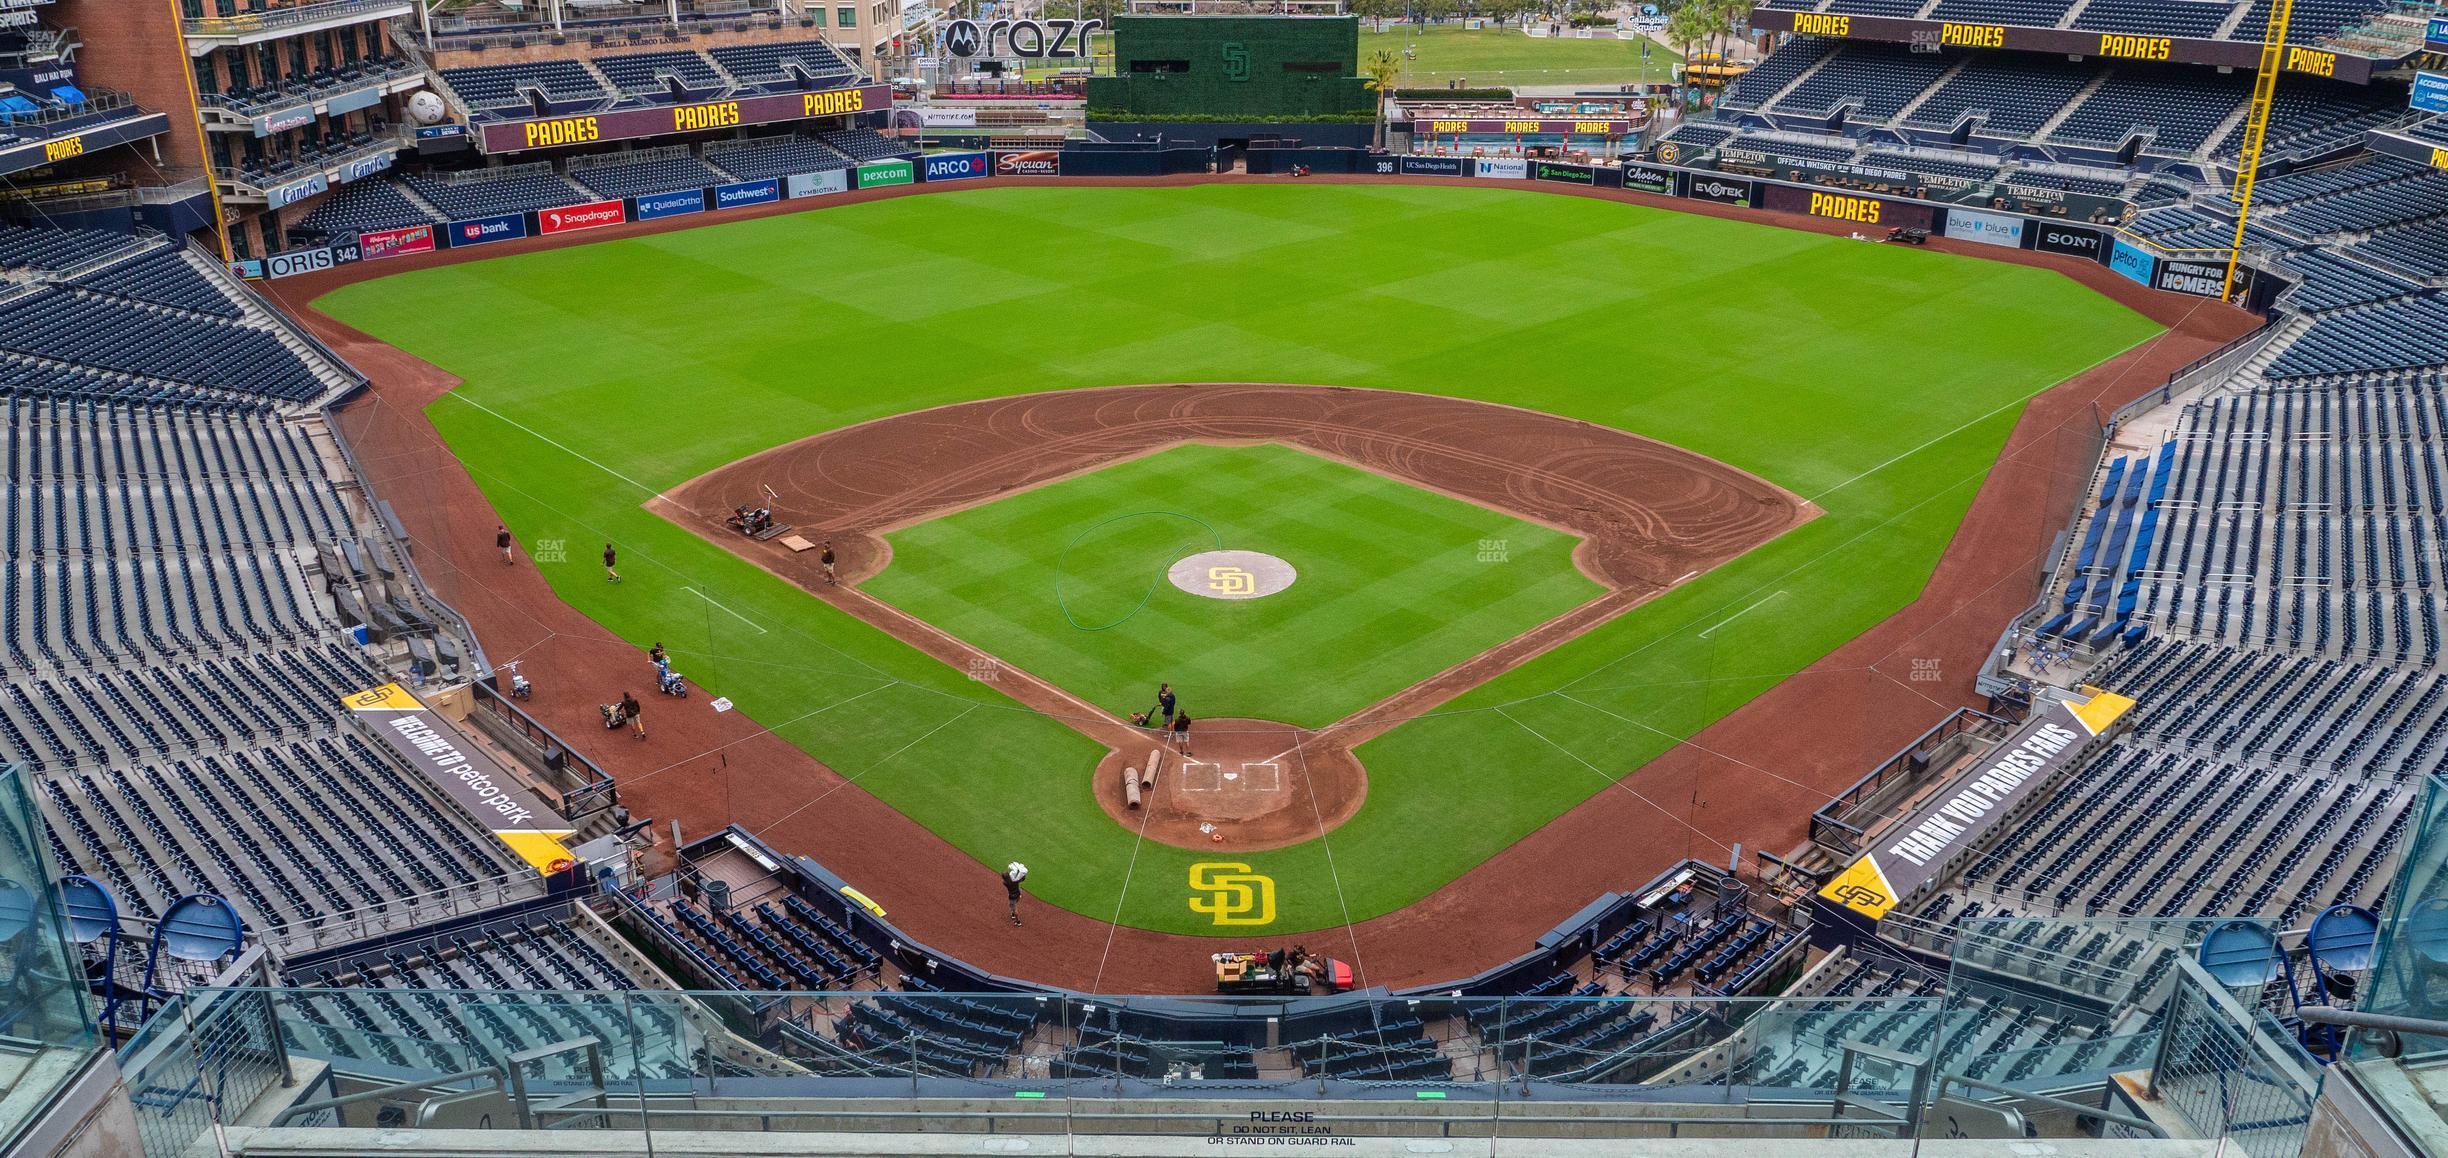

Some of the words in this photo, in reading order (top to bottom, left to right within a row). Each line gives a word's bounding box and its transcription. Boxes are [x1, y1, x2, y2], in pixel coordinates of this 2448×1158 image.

[1627, 15, 1669, 26] Gallagher
[1632, 24, 1662, 32] Square
[1794, 13, 1849, 36] PADRES
[986, 19, 1103, 58] razr
[1941, 23, 2004, 47] PADRES
[2100, 34, 2171, 60] PADRES
[2288, 48, 2335, 77] PADRES
[804, 90, 862, 116] PADRES
[673, 101, 739, 132] PADRES
[525, 117, 599, 147] PADRES
[1433, 120, 1467, 132] PADRES
[1505, 120, 1540, 132] PADRES
[1575, 121, 1610, 133] PADRES
[46, 137, 83, 161] PADRES
[1721, 150, 1766, 163] TEMPLETON
[928, 160, 969, 176] ARCO
[1000, 154, 1053, 173] Sycuan
[1377, 162, 1393, 173] 396
[1494, 163, 1523, 171] National
[1778, 157, 1806, 168] OFFICIAL
[1807, 161, 1835, 171] WHISKEY
[1864, 168, 1882, 177] DIEGO
[1883, 170, 1906, 181] PADRES
[1628, 168, 1664, 181] Chosen
[1918, 174, 1971, 190] TEMPLETON
[721, 187, 768, 202] Southwest
[799, 185, 838, 196] CYMBIOTIKA
[1695, 182, 1744, 198] EVOTEK
[2007, 185, 2065, 202] TEMPLETON
[653, 197, 701, 212] QuidelOrtho
[1810, 191, 1880, 223] PADRES
[564, 208, 618, 224] Snapdragon
[466, 227, 480, 236] us
[481, 221, 508, 234] bank
[1949, 217, 1972, 229] blue
[1985, 222, 2008, 234] blue
[2047, 232, 2098, 250] SONY
[272, 252, 331, 275] ORIS
[337, 246, 358, 263] 342
[2112, 247, 2138, 269] petco
[2168, 262, 2205, 276] HUNGRY
[2205, 267, 2223, 279] FOR
[2162, 273, 2225, 297] HOMERS
[389, 714, 448, 757] WELCOME
[2021, 723, 2078, 759] FANS
[437, 749, 466, 773] TO
[451, 763, 499, 796] petco
[1970, 749, 2045, 801] PADRES
[490, 792, 533, 824] park
[1949, 789, 1994, 825] YOU
[1889, 812, 1966, 866] THANK
[1189, 863, 1276, 925] SD
[1250, 1111, 1314, 1123] PLEASE
[1233, 1126, 1250, 1134] DO
[1253, 1126, 1275, 1134] NOT
[1279, 1126, 1298, 1136] SIT,
[1301, 1126, 1331, 1134] LEAN
[1207, 1137, 1223, 1145] OR
[1227, 1137, 1264, 1145] STAND
[1268, 1137, 1285, 1145] ON
[1288, 1138, 1328, 1146] GUARD
[1331, 1138, 1356, 1146] RAIL
